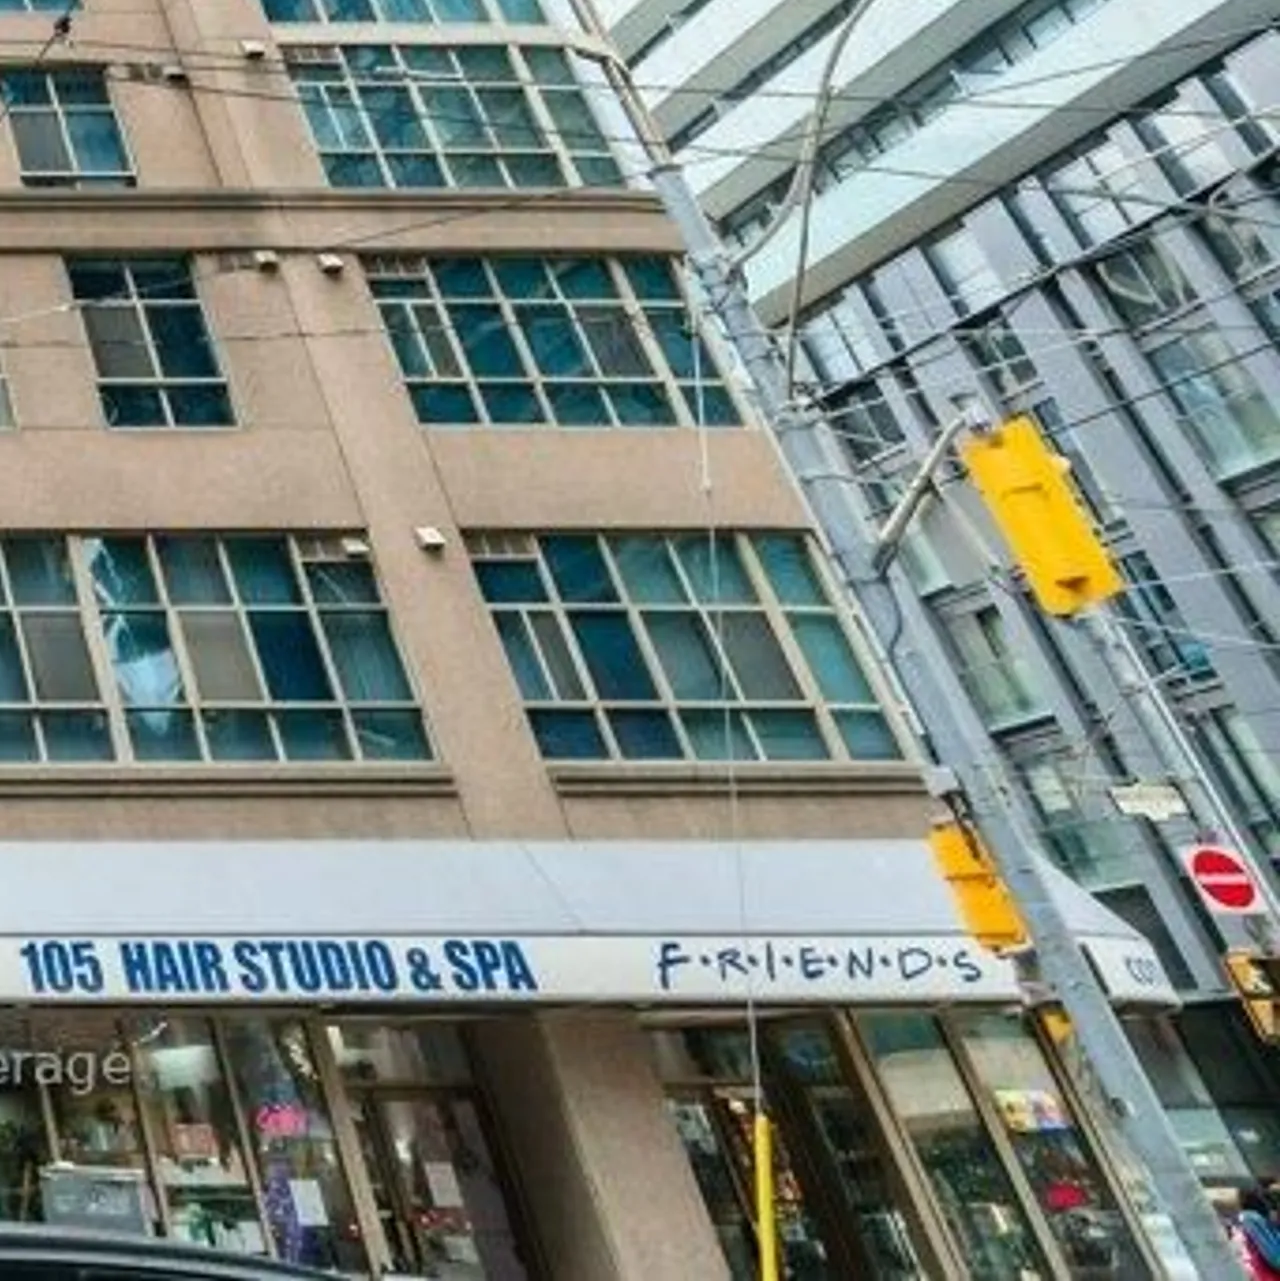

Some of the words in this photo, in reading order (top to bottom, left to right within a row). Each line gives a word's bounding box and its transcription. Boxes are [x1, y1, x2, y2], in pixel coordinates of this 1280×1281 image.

[19, 939, 105, 993] 105
[119, 940, 230, 993] HAIR
[230, 940, 400, 992] STUDIO
[405, 946, 442, 992] &
[444, 939, 538, 991] SPA
